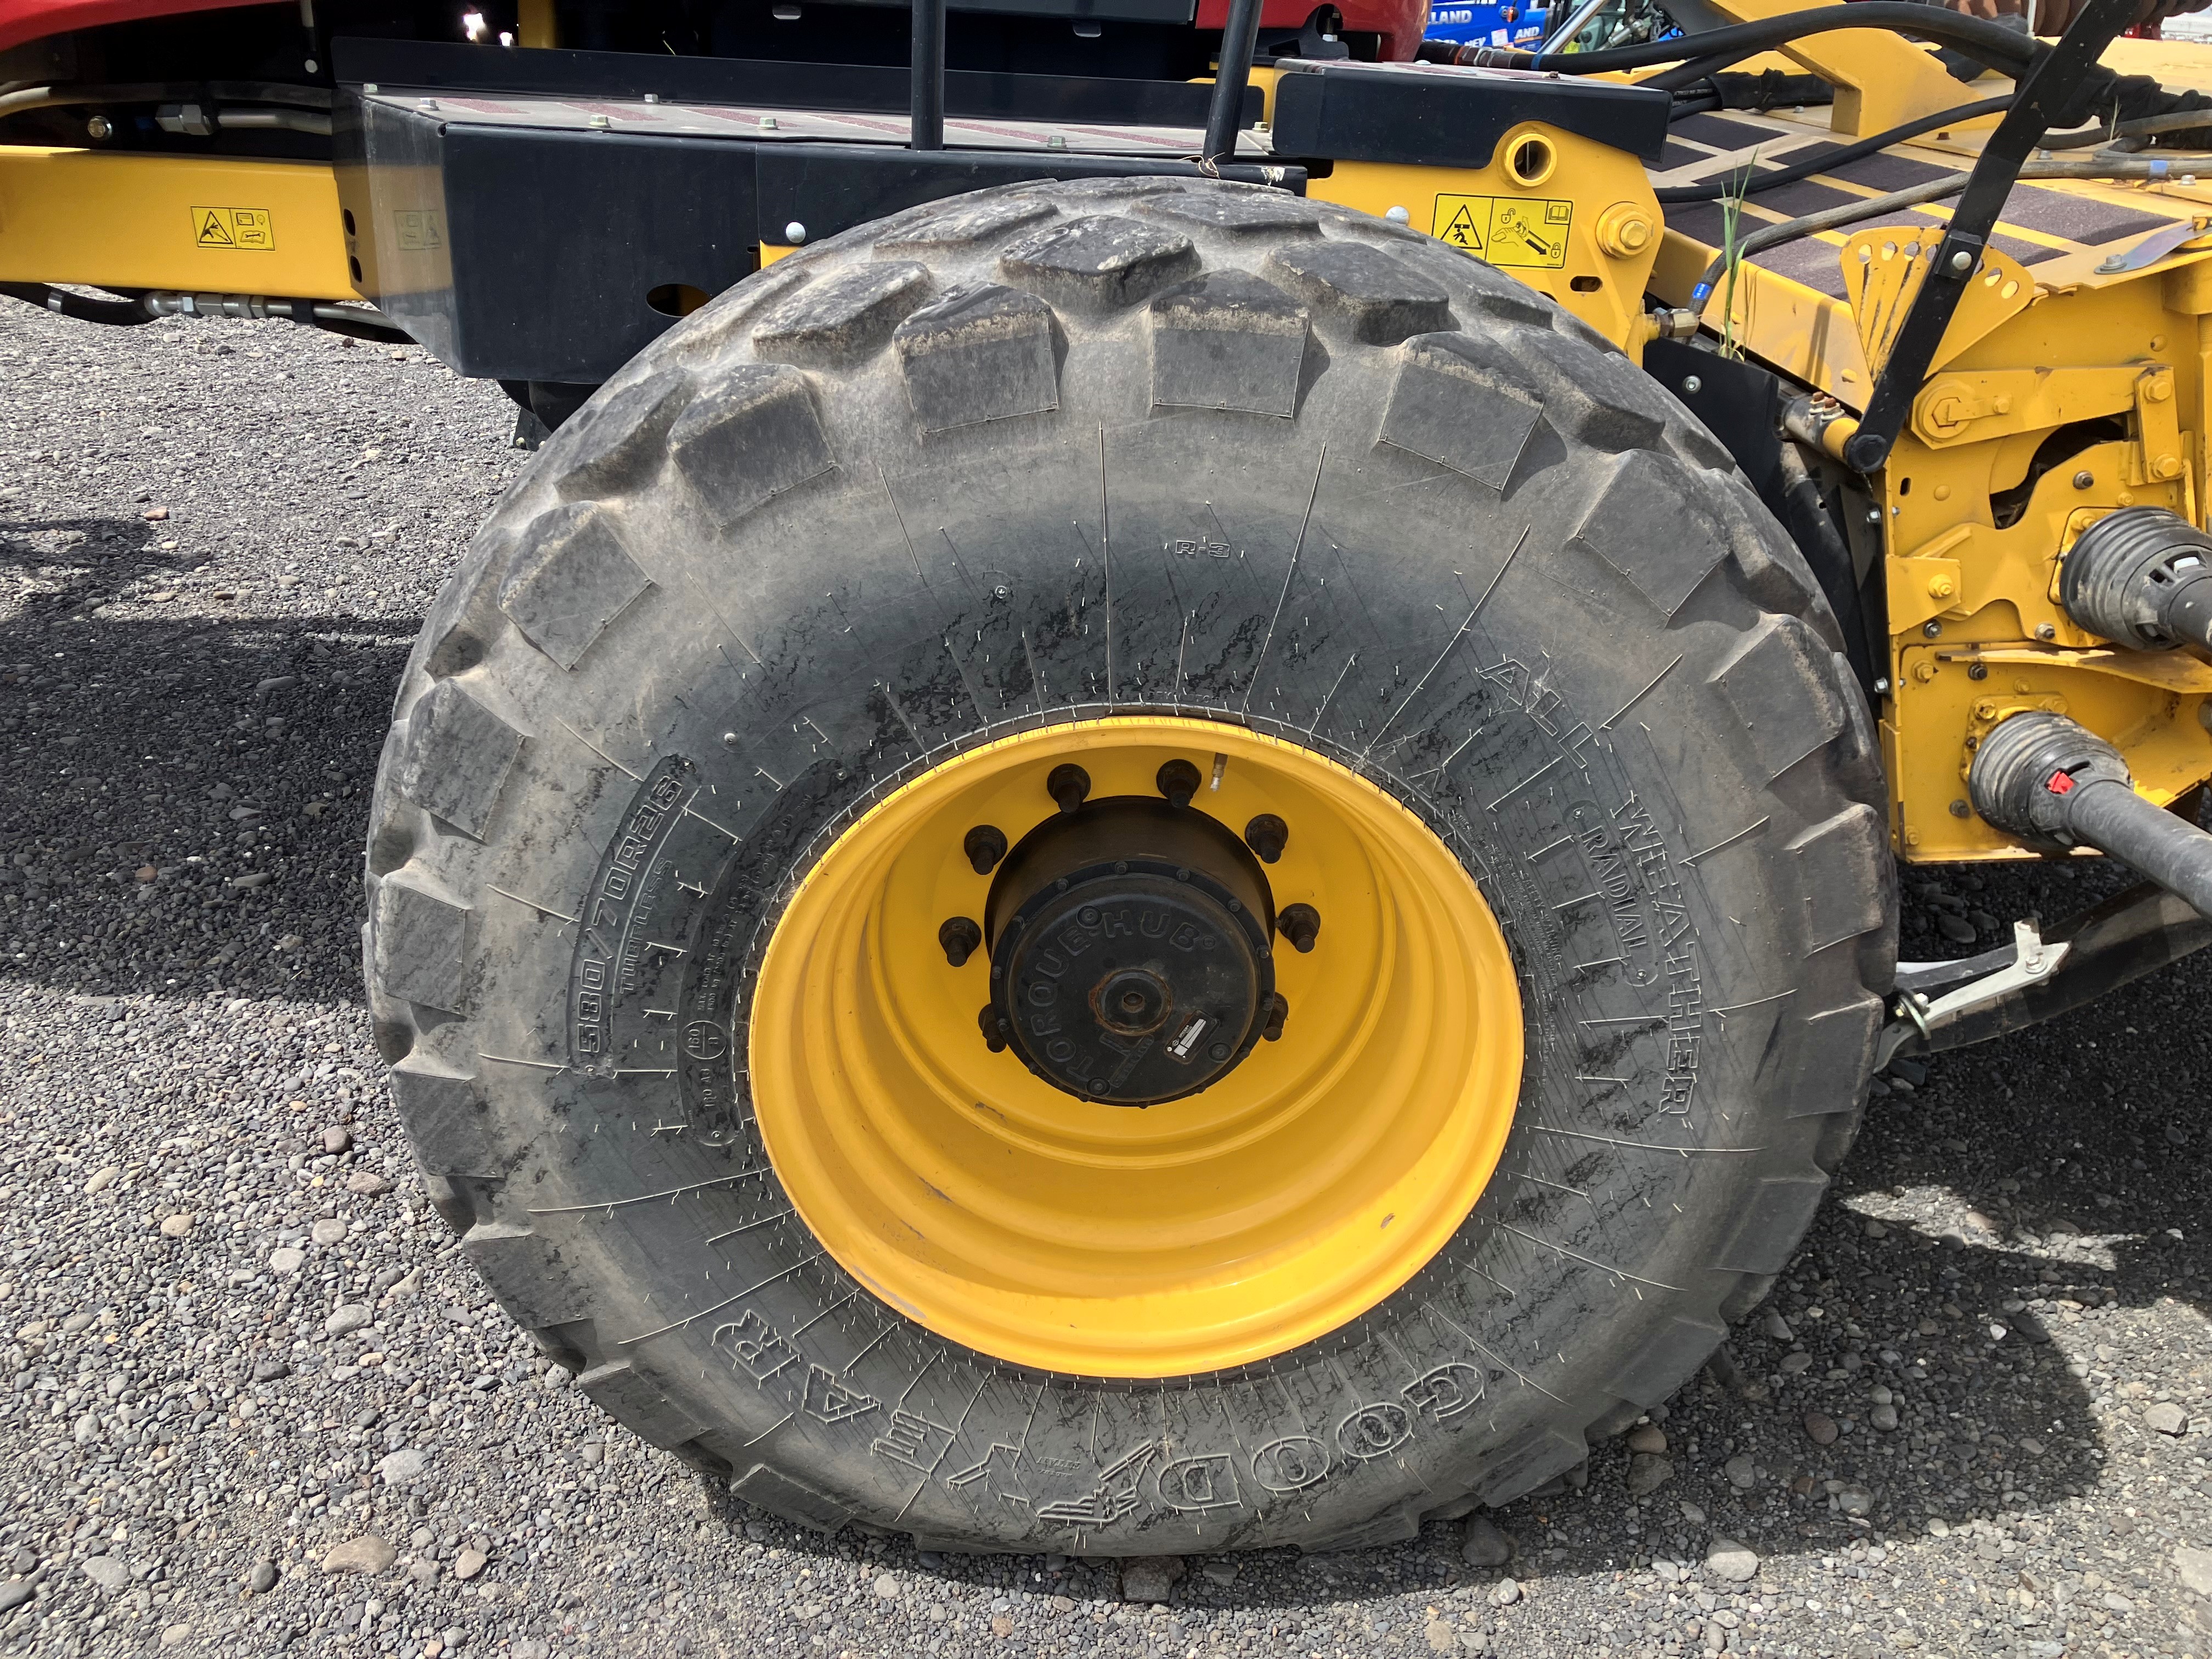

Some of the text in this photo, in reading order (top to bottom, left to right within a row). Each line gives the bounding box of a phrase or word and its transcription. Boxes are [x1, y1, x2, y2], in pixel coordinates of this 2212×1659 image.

[1175, 540, 1230, 557] R-3
[578, 775, 683, 1053] 580/70R26
[619, 857, 672, 994] TUBELESS
[1479, 659, 1701, 1114] ALL WEATHER
[1579, 825, 1646, 957] RADIAL
[710, 1309, 1485, 1524] GOODYEAR
